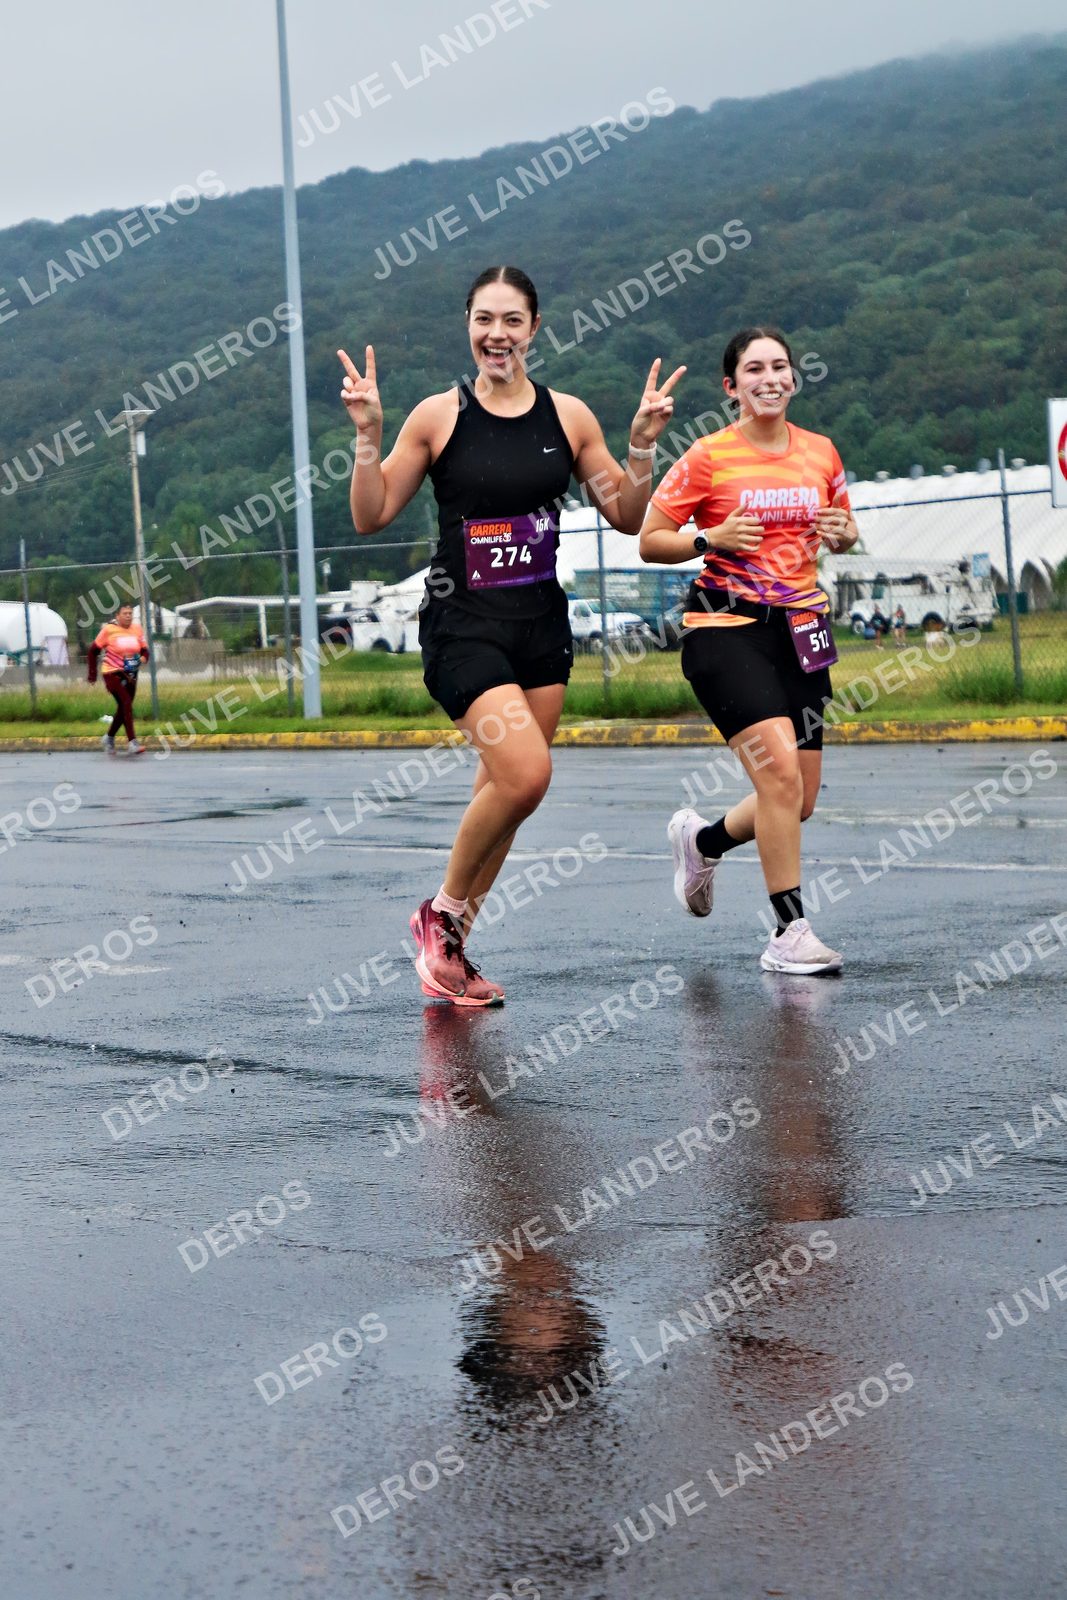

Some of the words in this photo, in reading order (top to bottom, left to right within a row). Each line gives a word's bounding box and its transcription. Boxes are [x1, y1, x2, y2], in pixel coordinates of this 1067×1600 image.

[740, 487, 819, 509] CARRERA
[470, 523, 512, 537] CARRERA
[490, 545, 532, 568] 274
